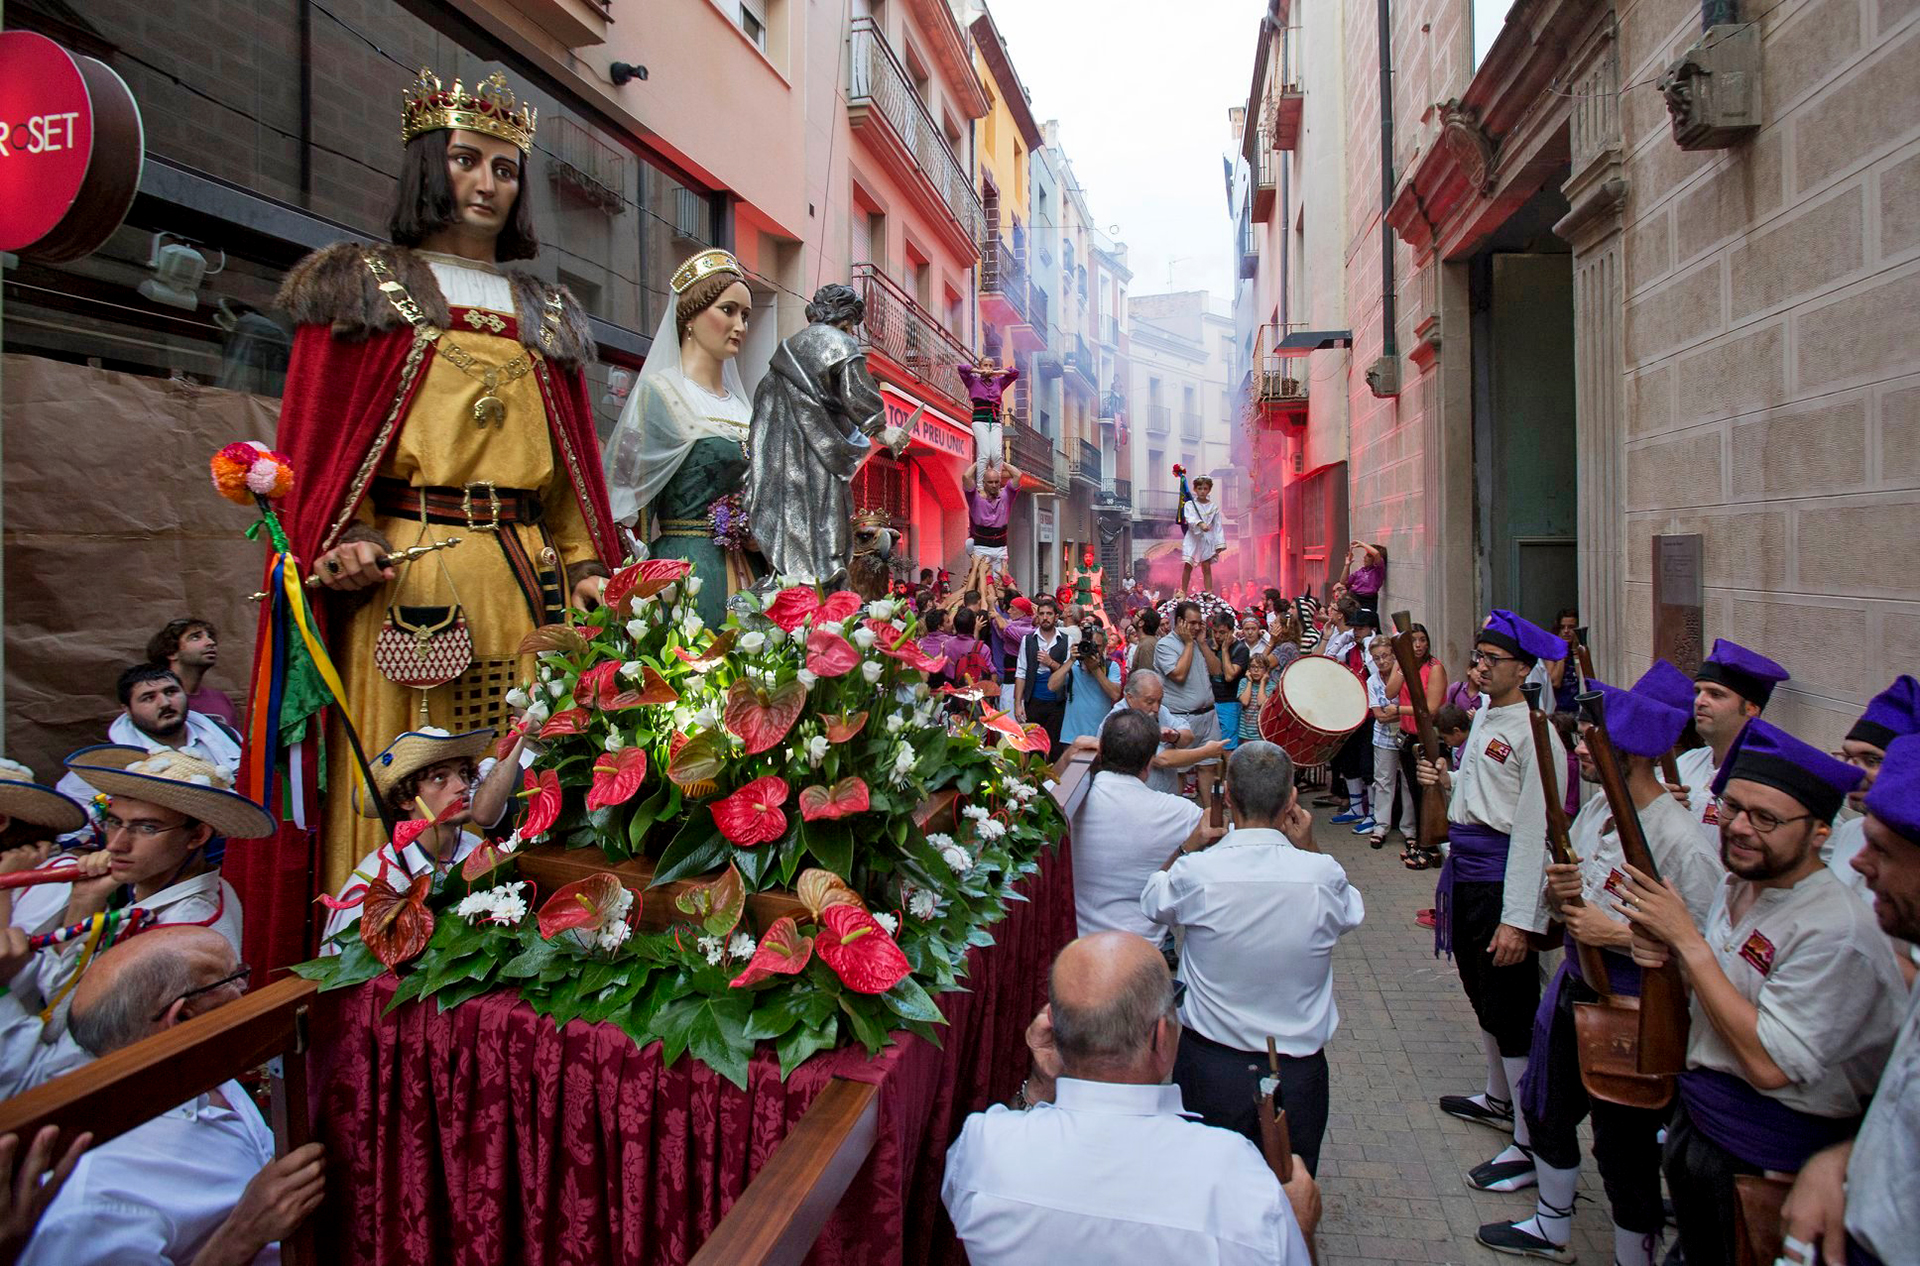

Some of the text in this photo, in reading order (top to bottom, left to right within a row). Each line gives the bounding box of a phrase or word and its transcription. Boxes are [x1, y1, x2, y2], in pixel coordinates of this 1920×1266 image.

[912, 421, 920, 436] A
[923, 422, 945, 446] PREU
[946, 428, 965, 456] ÚNIC
